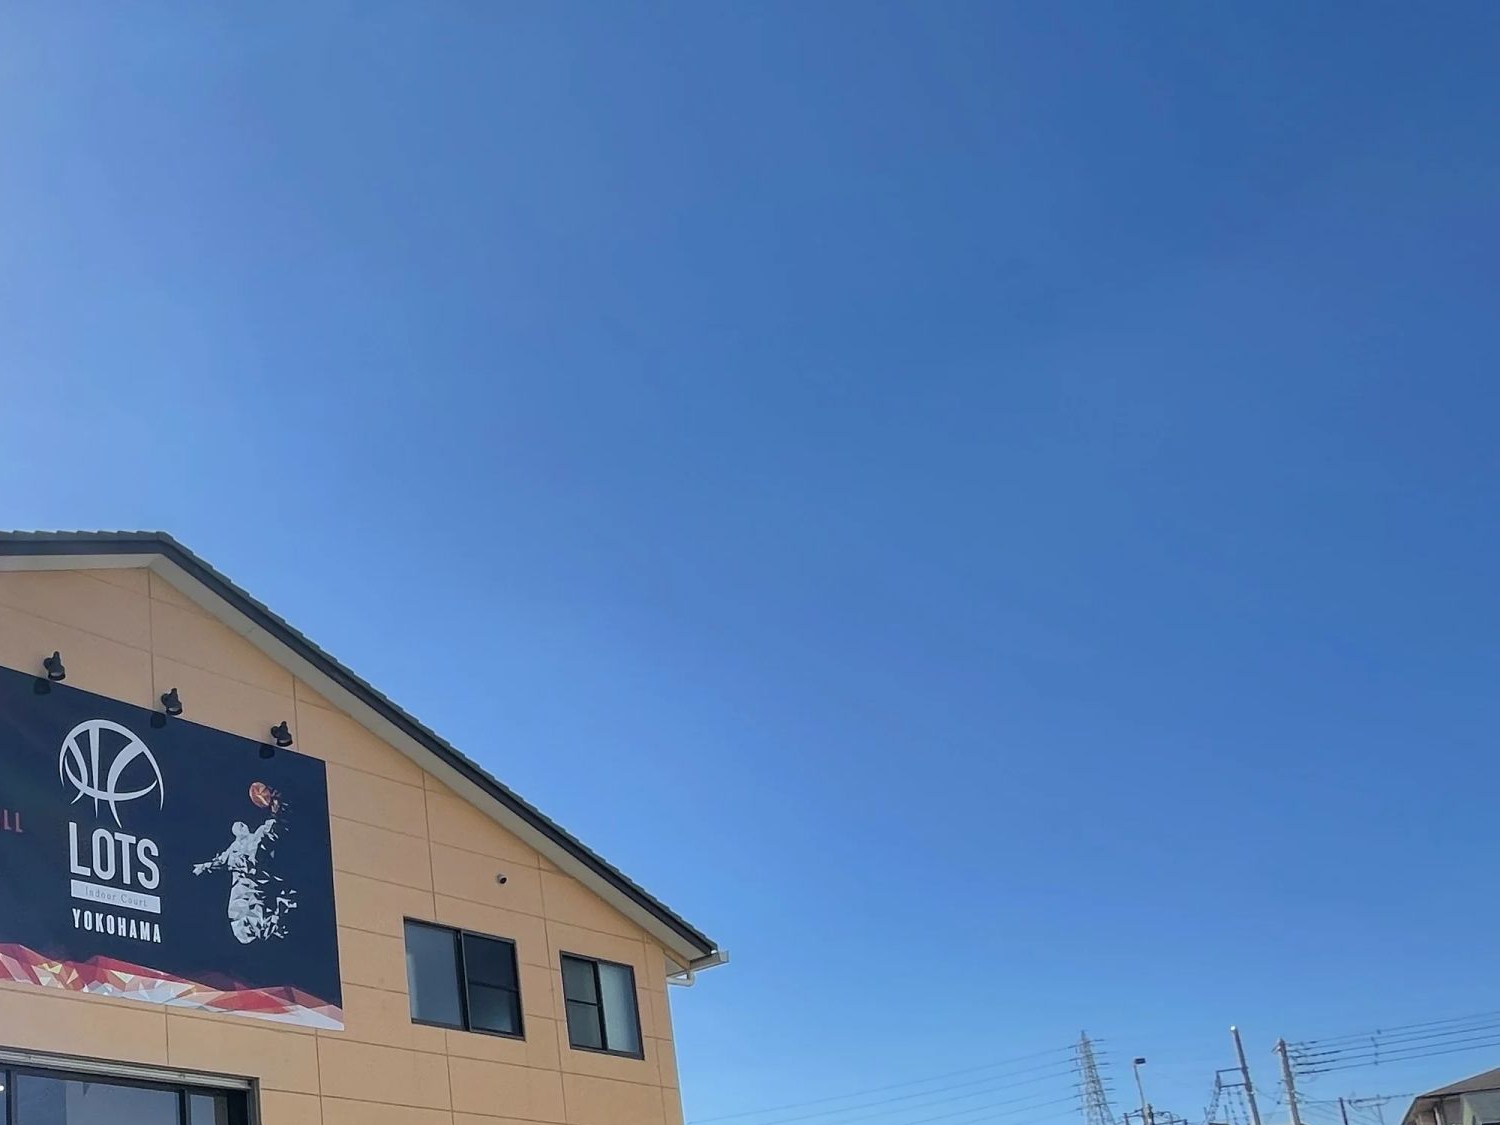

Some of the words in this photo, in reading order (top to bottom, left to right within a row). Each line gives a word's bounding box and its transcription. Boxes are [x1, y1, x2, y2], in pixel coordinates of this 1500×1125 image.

[68, 821, 160, 890] LOTS
[84, 886, 117, 901] Indoor
[120, 893, 148, 908] Court
[72, 908, 161, 943] YOKOHAMA
